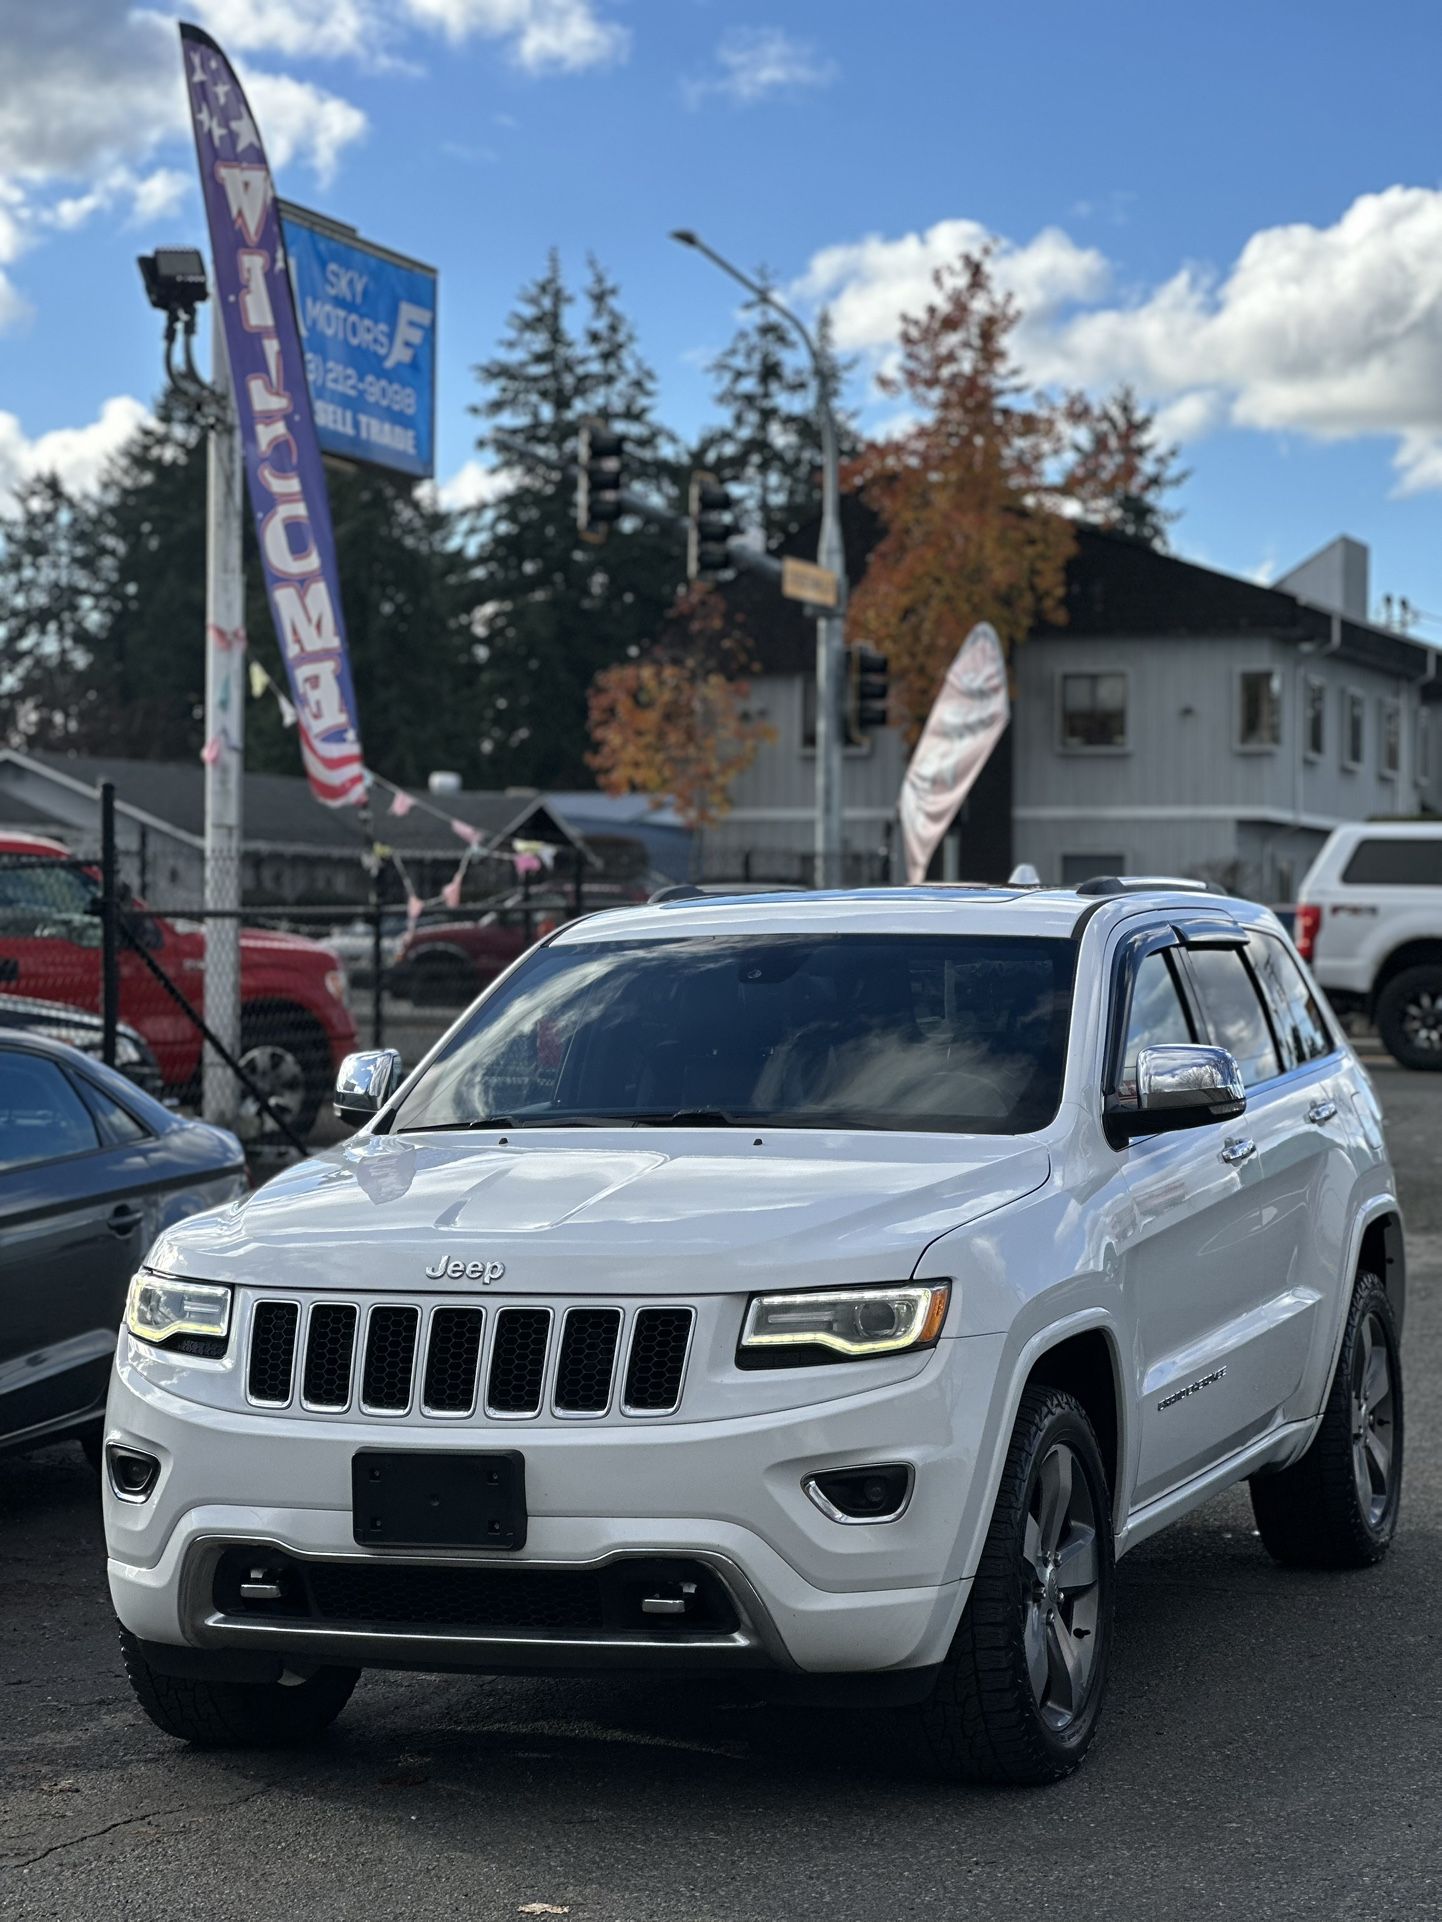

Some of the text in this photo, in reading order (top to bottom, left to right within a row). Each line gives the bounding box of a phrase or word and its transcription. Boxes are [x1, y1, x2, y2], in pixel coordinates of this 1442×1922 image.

[325, 262, 368, 305] SKY
[305, 295, 390, 356] MOTORS
[314, 399, 417, 455] SELL TRADE
[425, 1254, 505, 1285] Jeep
